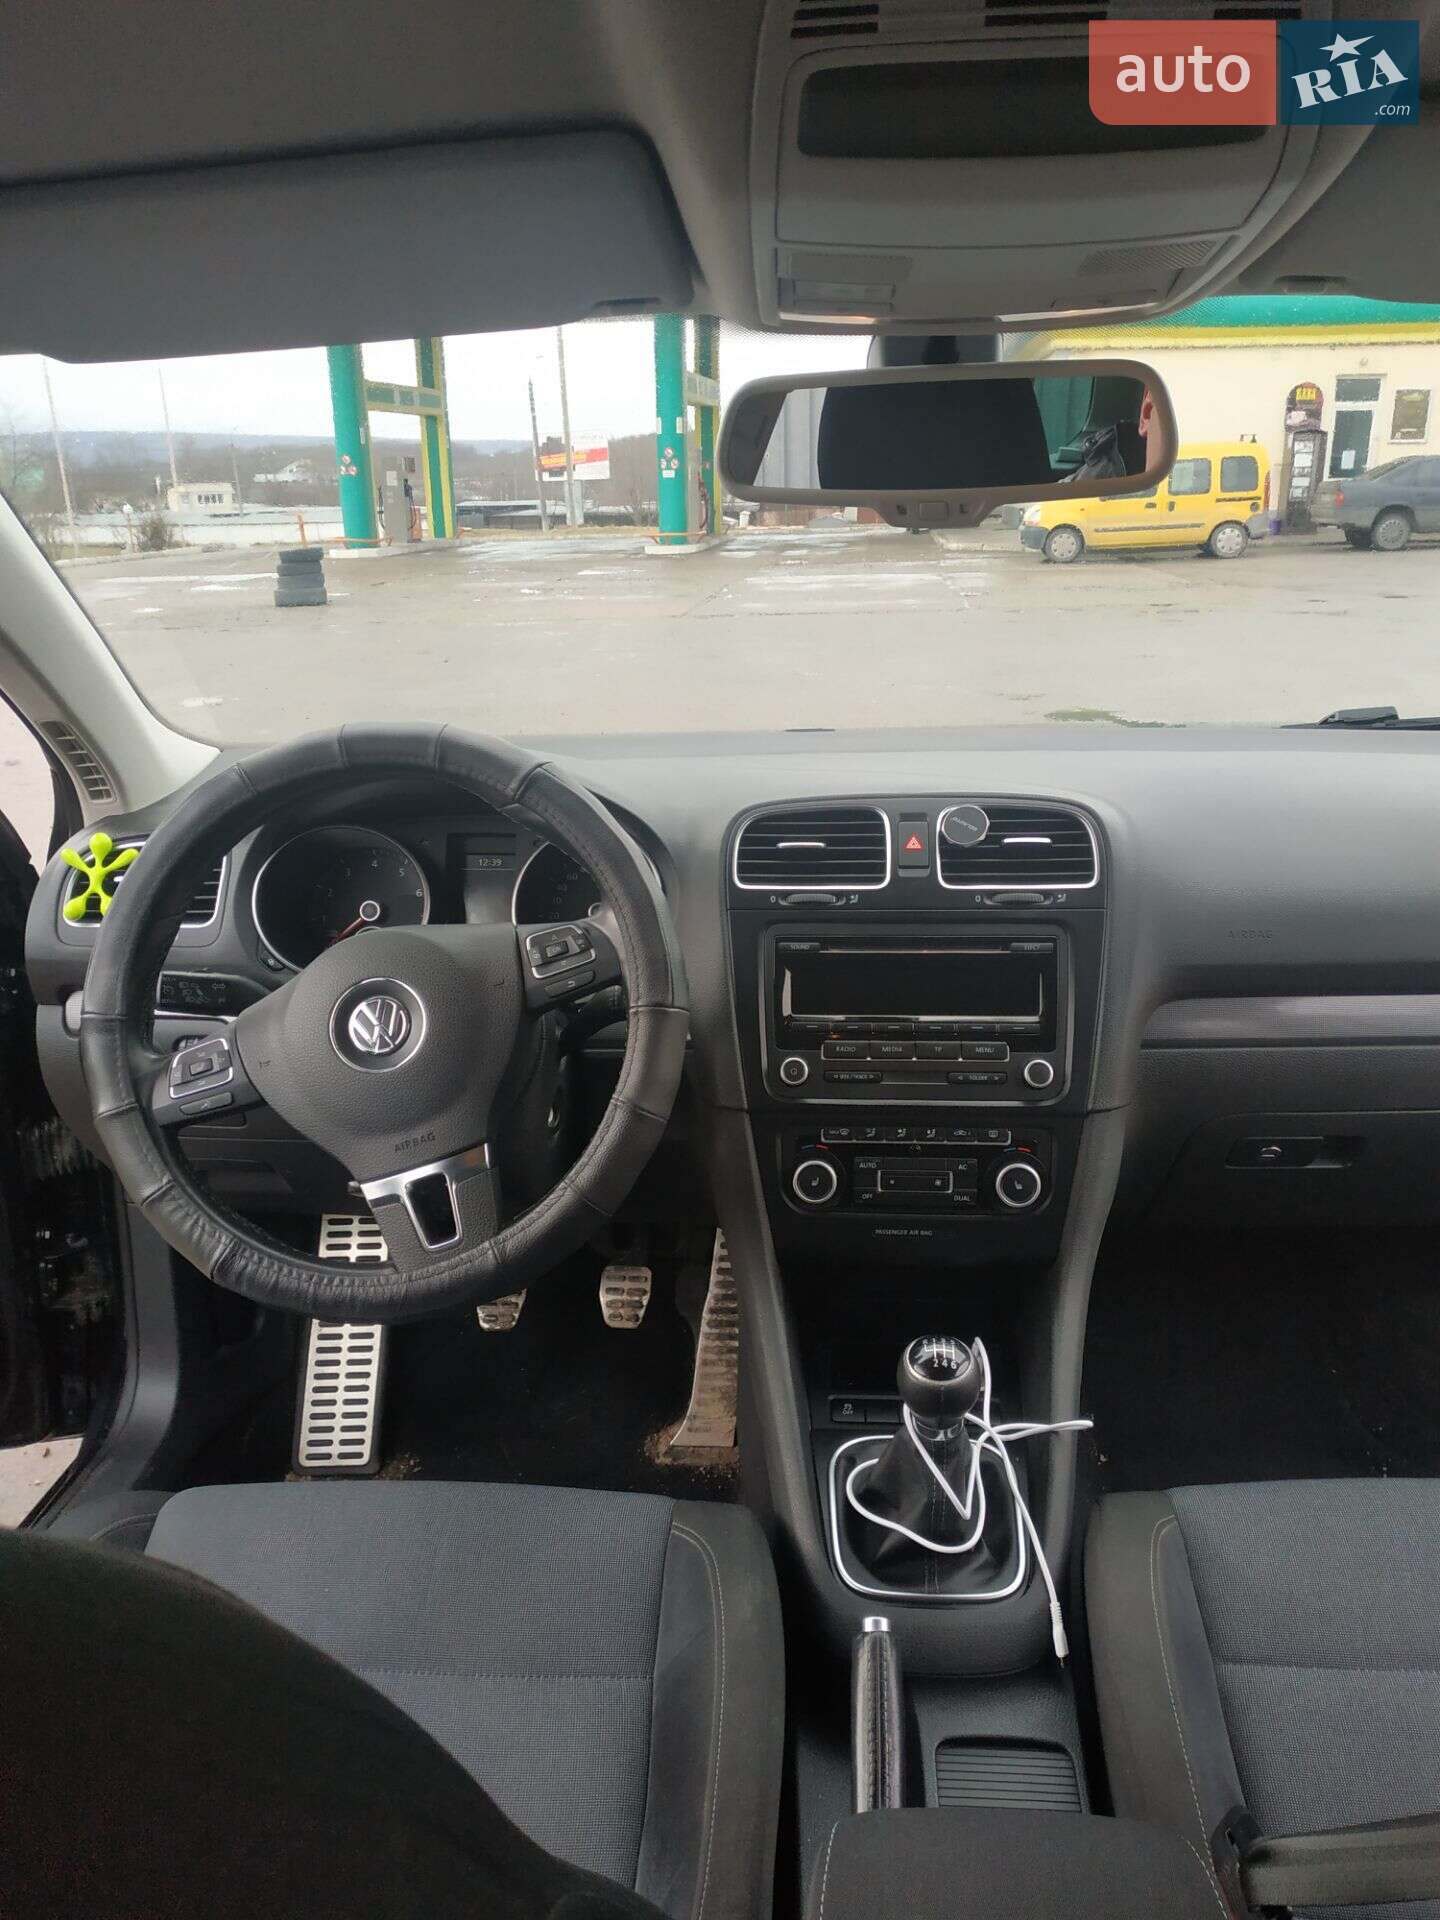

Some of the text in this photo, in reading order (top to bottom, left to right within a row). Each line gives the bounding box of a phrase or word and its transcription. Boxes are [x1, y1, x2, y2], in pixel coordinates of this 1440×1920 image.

[859, 1161, 877, 1169] AUTO
[953, 1194, 971, 1202] DUAL
[933, 1358, 957, 1370] 2 4 6
